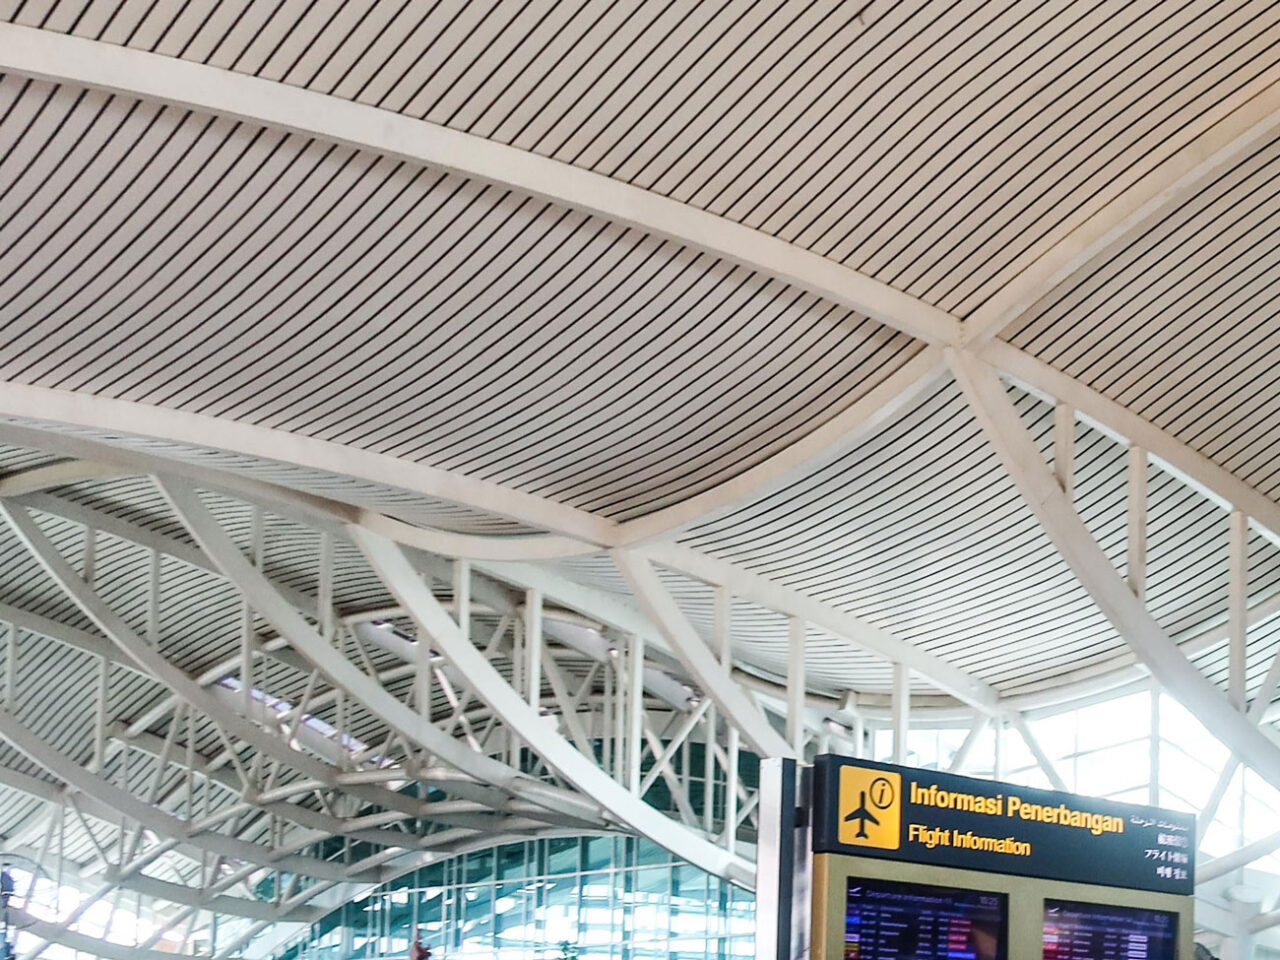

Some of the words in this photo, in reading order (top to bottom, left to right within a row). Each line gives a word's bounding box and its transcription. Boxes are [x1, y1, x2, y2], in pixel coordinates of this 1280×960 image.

[909, 781, 1003, 816] Informasi
[1007, 796, 1125, 836] Penerbangan
[908, 823, 951, 849] Flight
[952, 829, 1032, 857] Information
